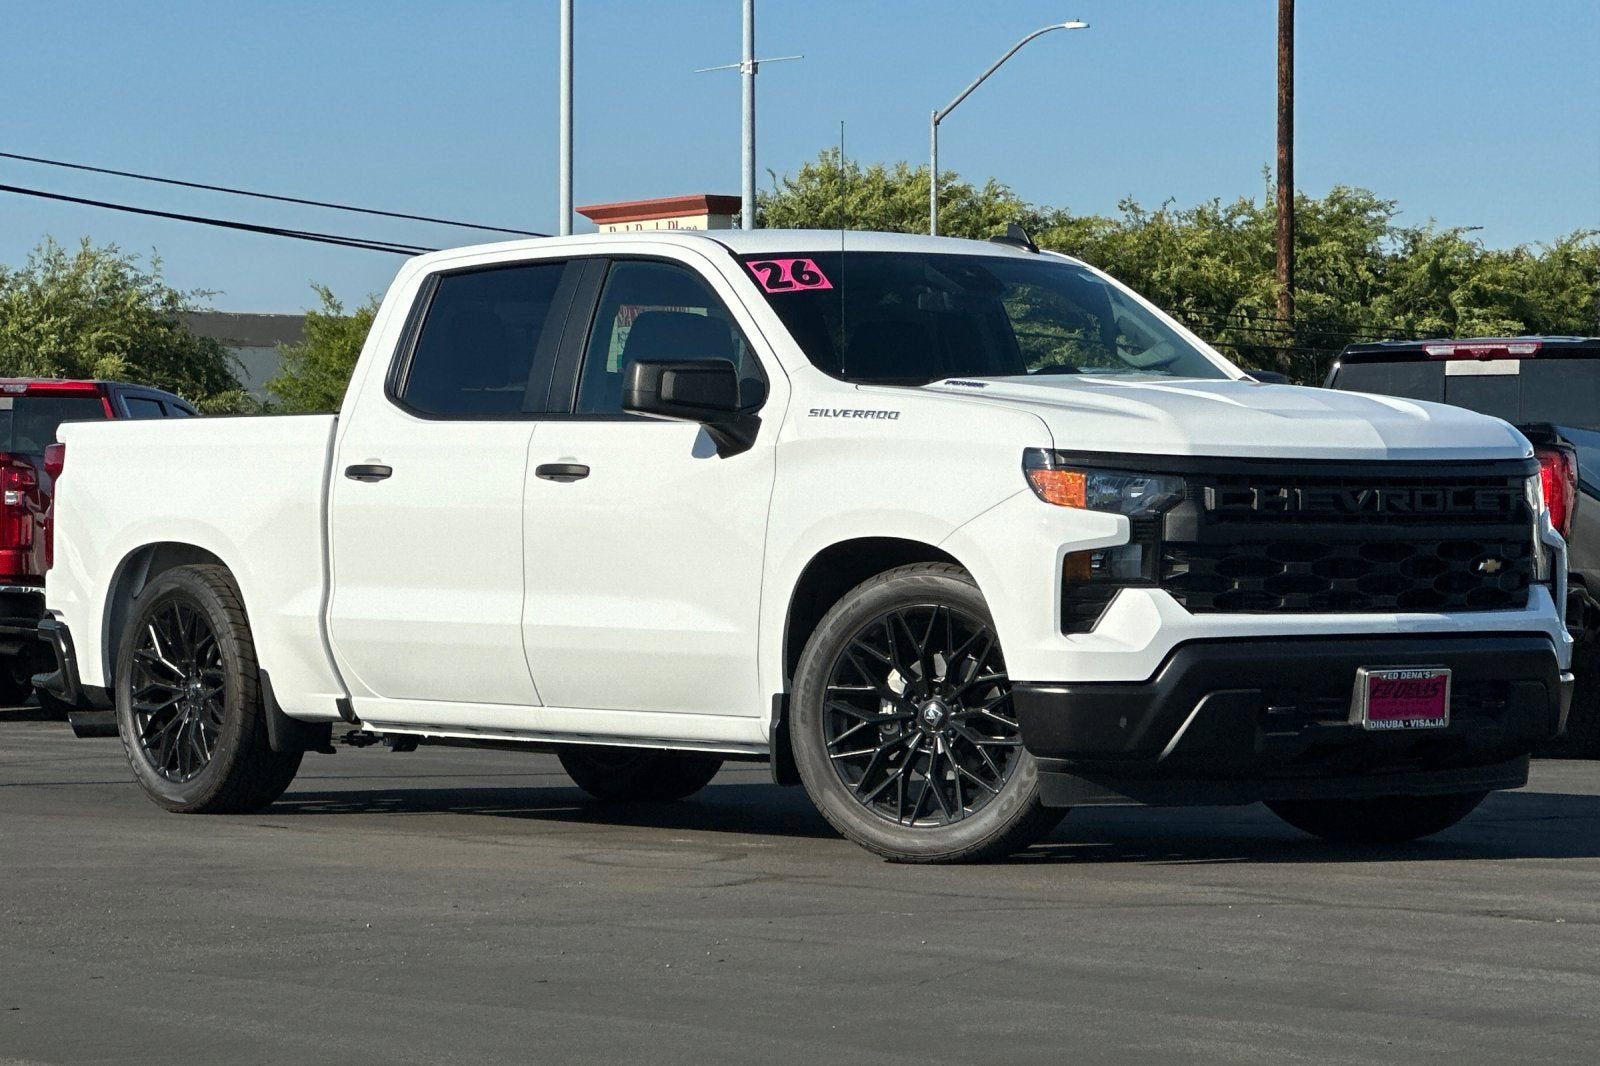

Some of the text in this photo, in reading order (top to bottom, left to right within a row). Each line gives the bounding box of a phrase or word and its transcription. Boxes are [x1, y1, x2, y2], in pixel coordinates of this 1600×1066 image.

[752, 260, 823, 290] 26
[807, 408, 901, 421] SILVERADO
[1204, 487, 1523, 512] CHEVROLET
[1401, 671, 1431, 679] DENA'S
[1370, 719, 1404, 729] DINUBA
